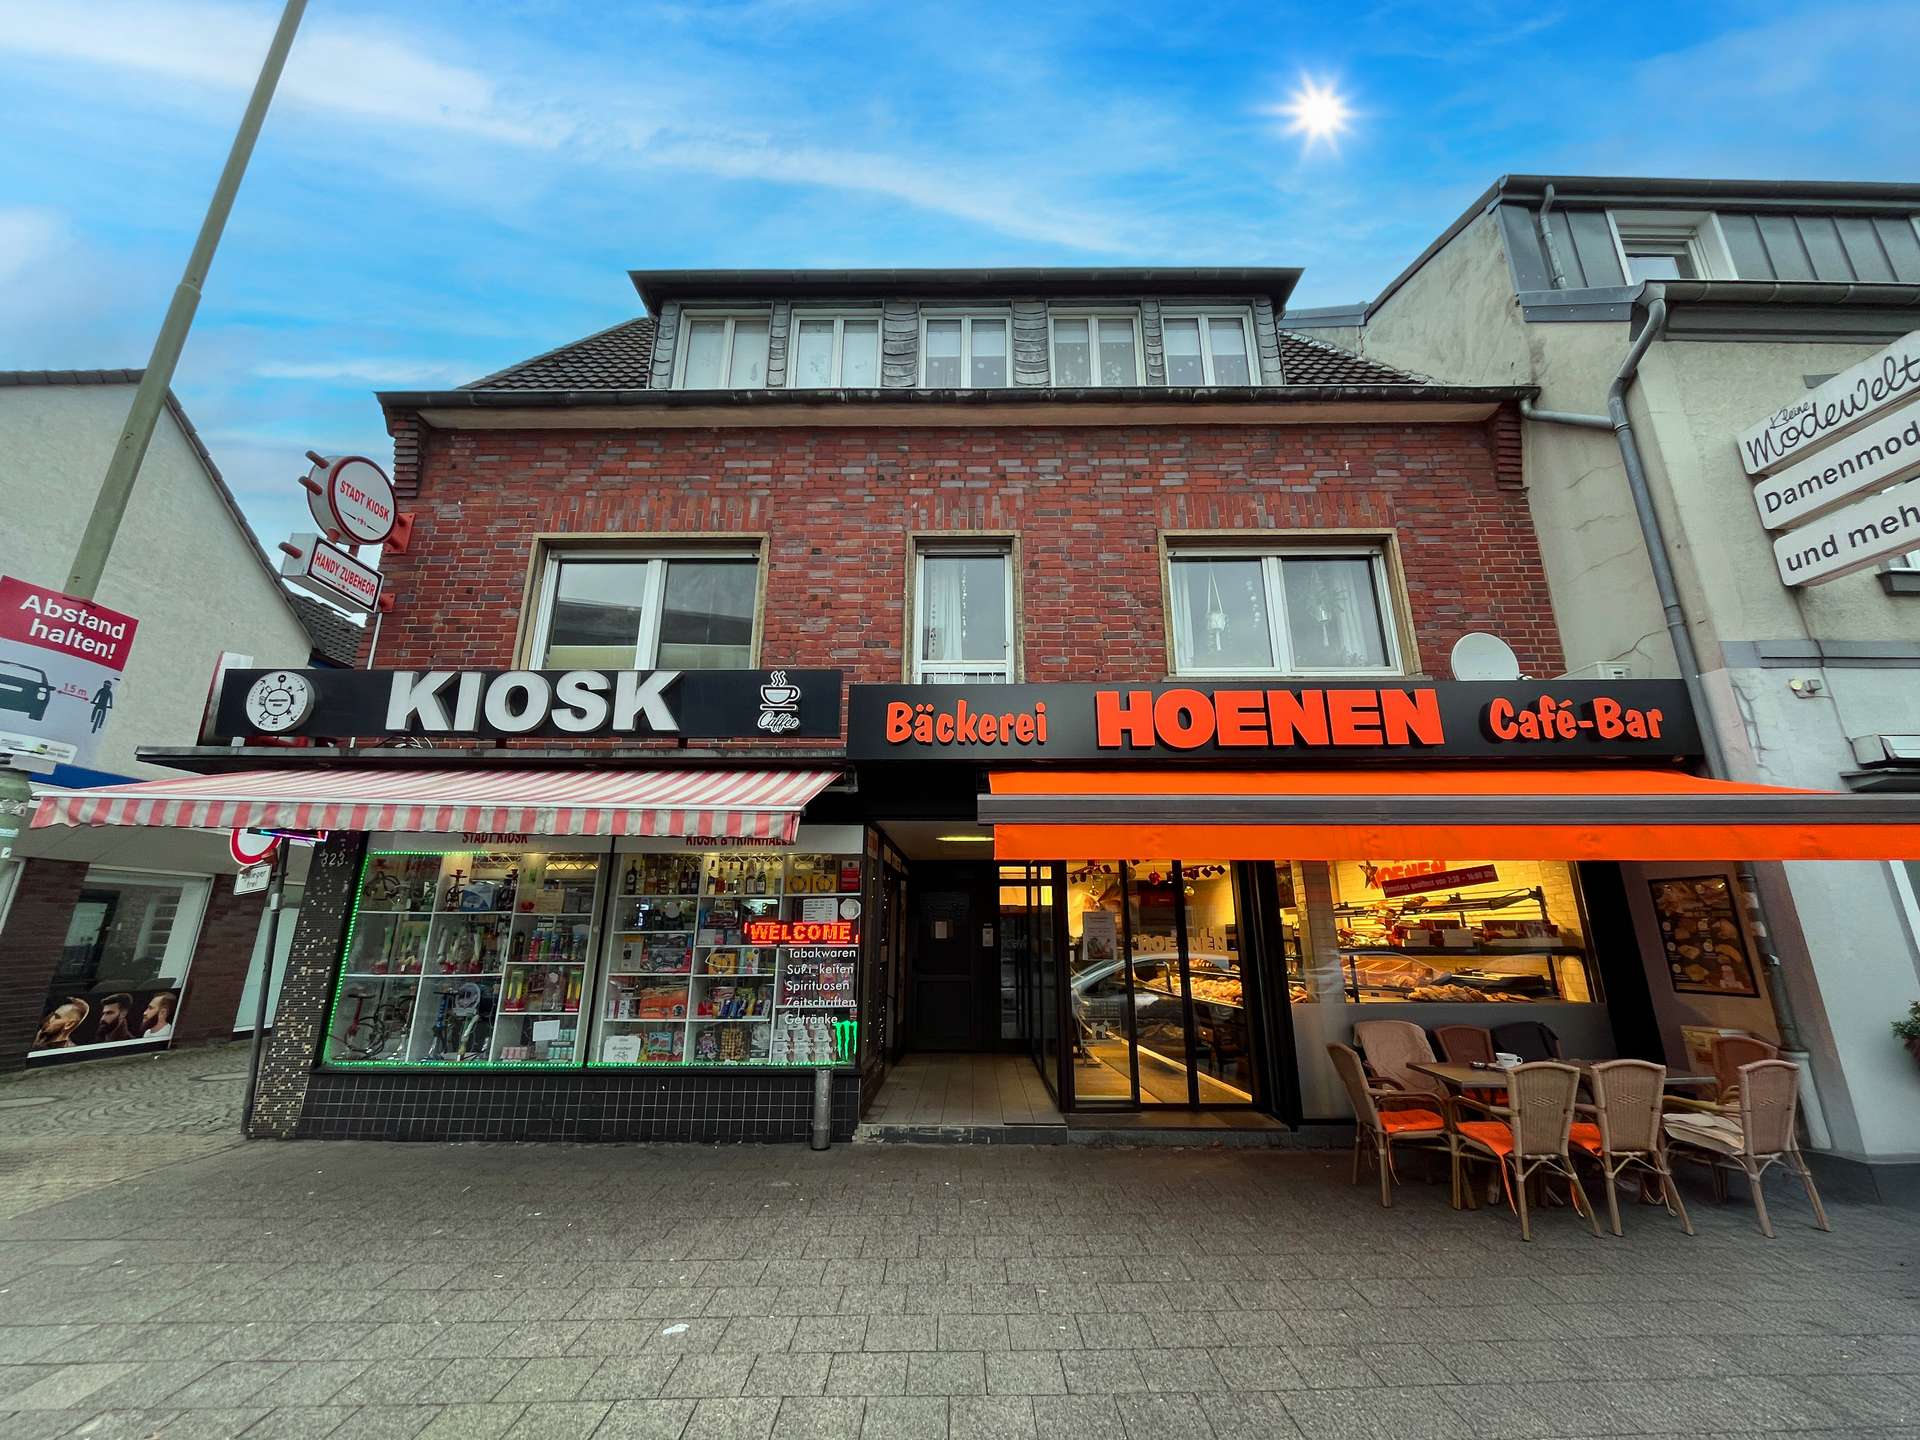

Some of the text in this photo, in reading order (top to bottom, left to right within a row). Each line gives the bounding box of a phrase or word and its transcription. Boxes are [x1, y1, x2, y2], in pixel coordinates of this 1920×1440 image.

[1770, 401, 1811, 430] Kleine
[1764, 420, 1920, 513] Damenmod
[340, 480, 390, 522] STADT KIOSK
[314, 551, 341, 576] HANDY
[1786, 534, 1840, 572] und
[20, 594, 126, 640] Abstand
[29, 618, 117, 660] halten!
[385, 670, 684, 732] KIOSK
[886, 688, 1664, 749] Bäckerei HOENEN Café-Bar
[750, 924, 851, 940] WELCOME
[788, 948, 856, 958] Tabakwaren
[787, 963, 854, 977] Süßikeiten
[785, 996, 857, 1007] Zeitschriften
[786, 981, 850, 993] Spirituosen
[784, 1013, 838, 1025] Getränke
